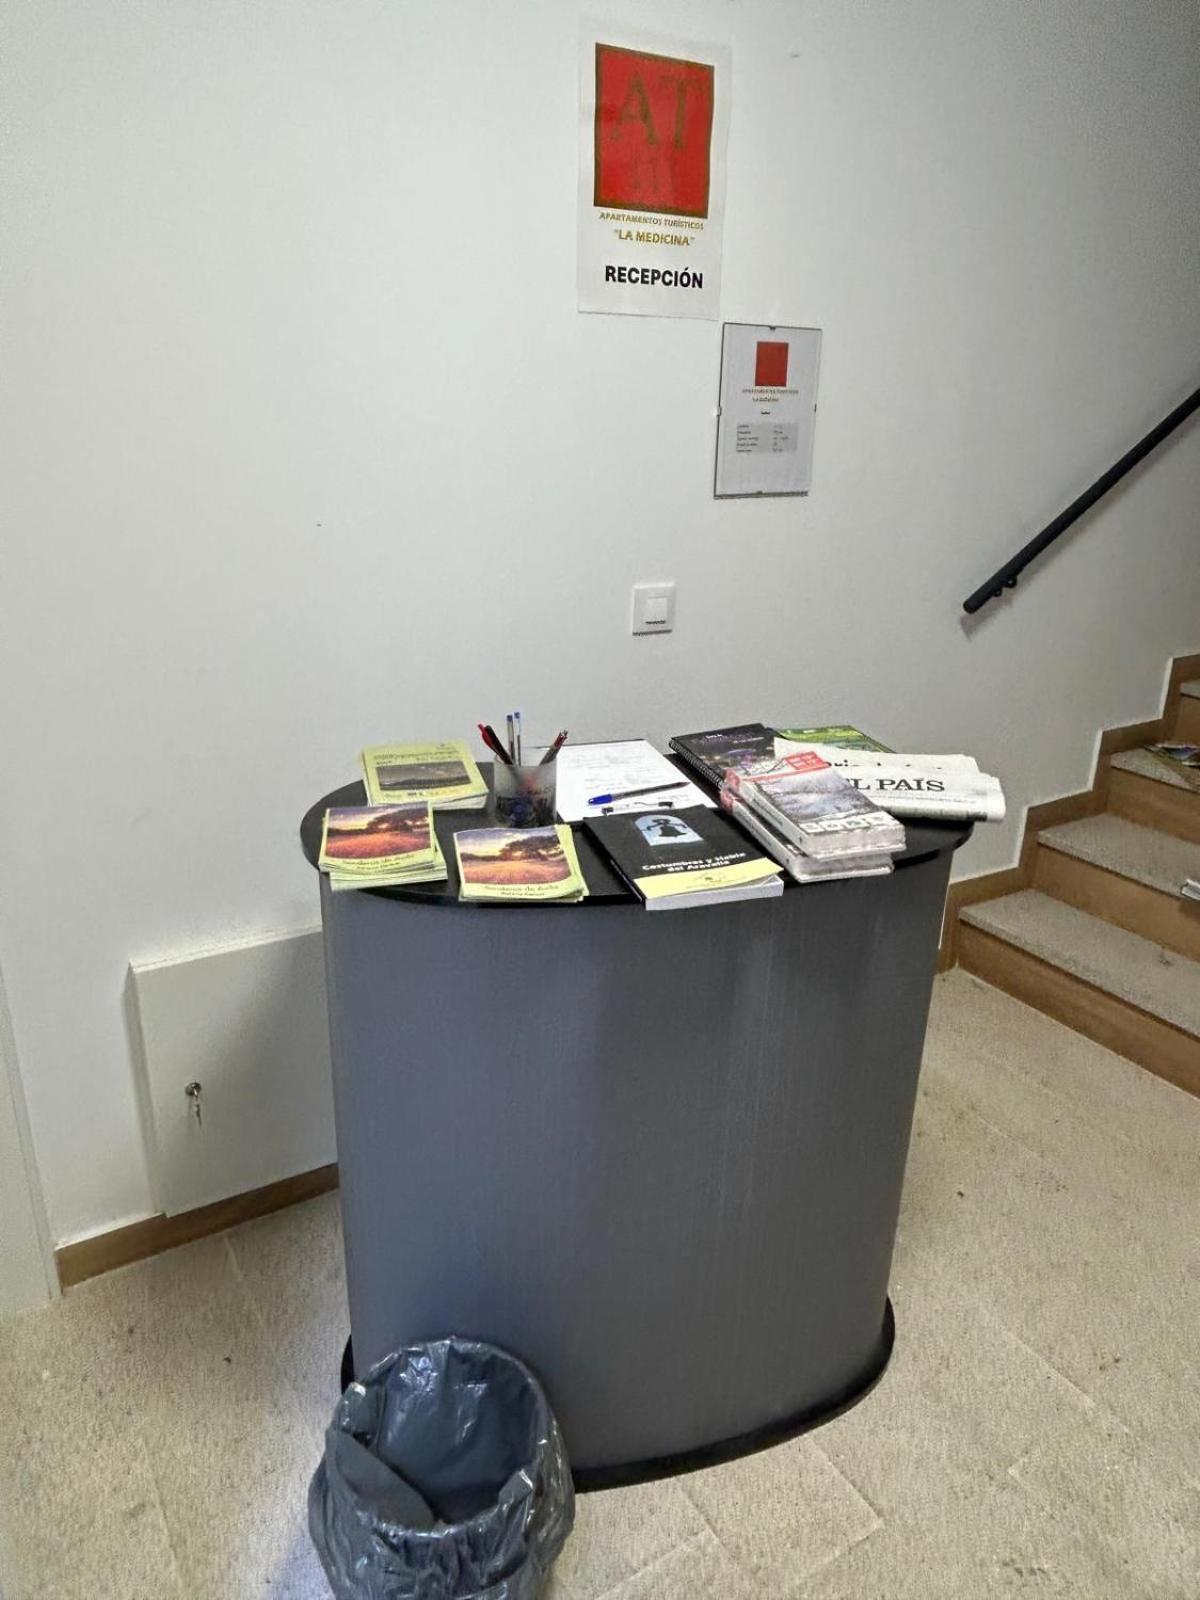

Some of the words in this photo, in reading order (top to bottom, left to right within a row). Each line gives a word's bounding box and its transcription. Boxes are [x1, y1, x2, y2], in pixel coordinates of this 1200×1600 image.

[610, 71, 703, 150] AT
[600, 212, 661, 225] APARTAMENTOS
[664, 218, 704, 230] TURÍSTICOS
[605, 265, 703, 288] RECEPCIÓN
[642, 859, 703, 870] Costumbres
